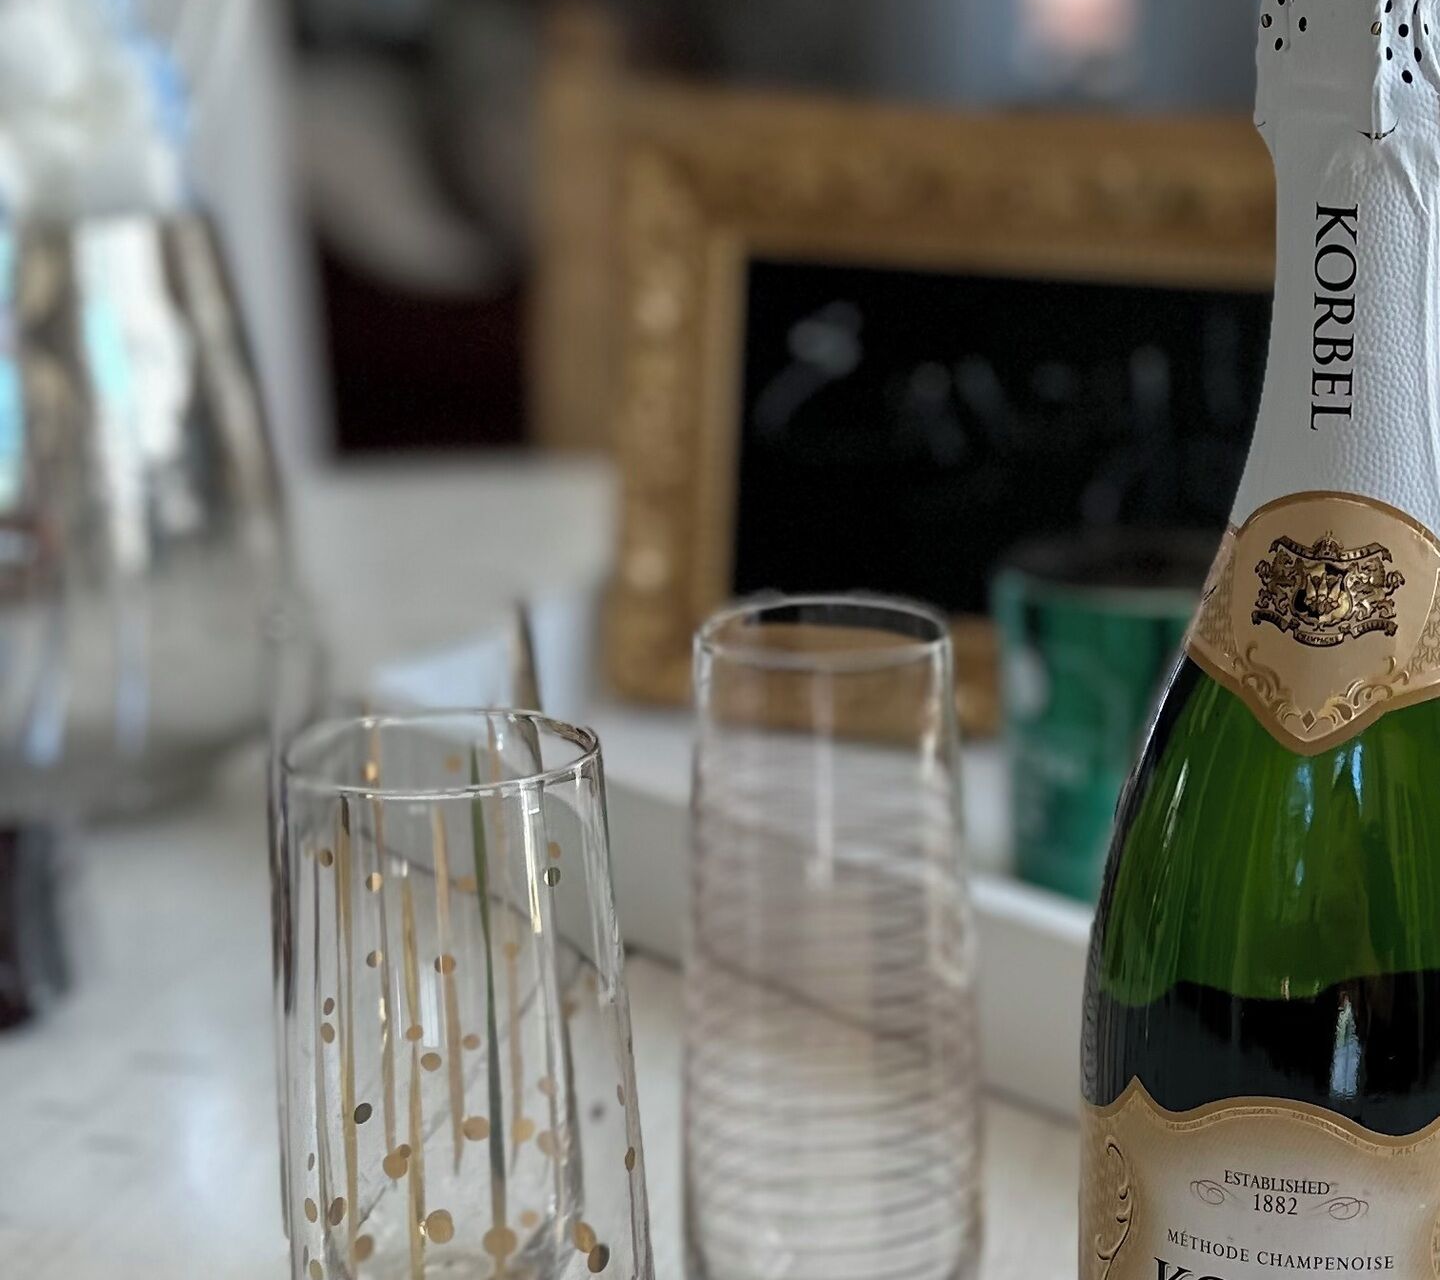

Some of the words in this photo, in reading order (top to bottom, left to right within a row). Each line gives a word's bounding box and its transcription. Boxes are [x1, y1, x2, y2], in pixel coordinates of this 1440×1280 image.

[1311, 200, 1359, 431] KORBEL
[1224, 1170, 1330, 1195] ESTABLISHED
[1253, 1193, 1298, 1215] 1882
[1167, 1227, 1249, 1263] MÉTHODE
[1257, 1251, 1394, 1270] CHAMPENOISE
